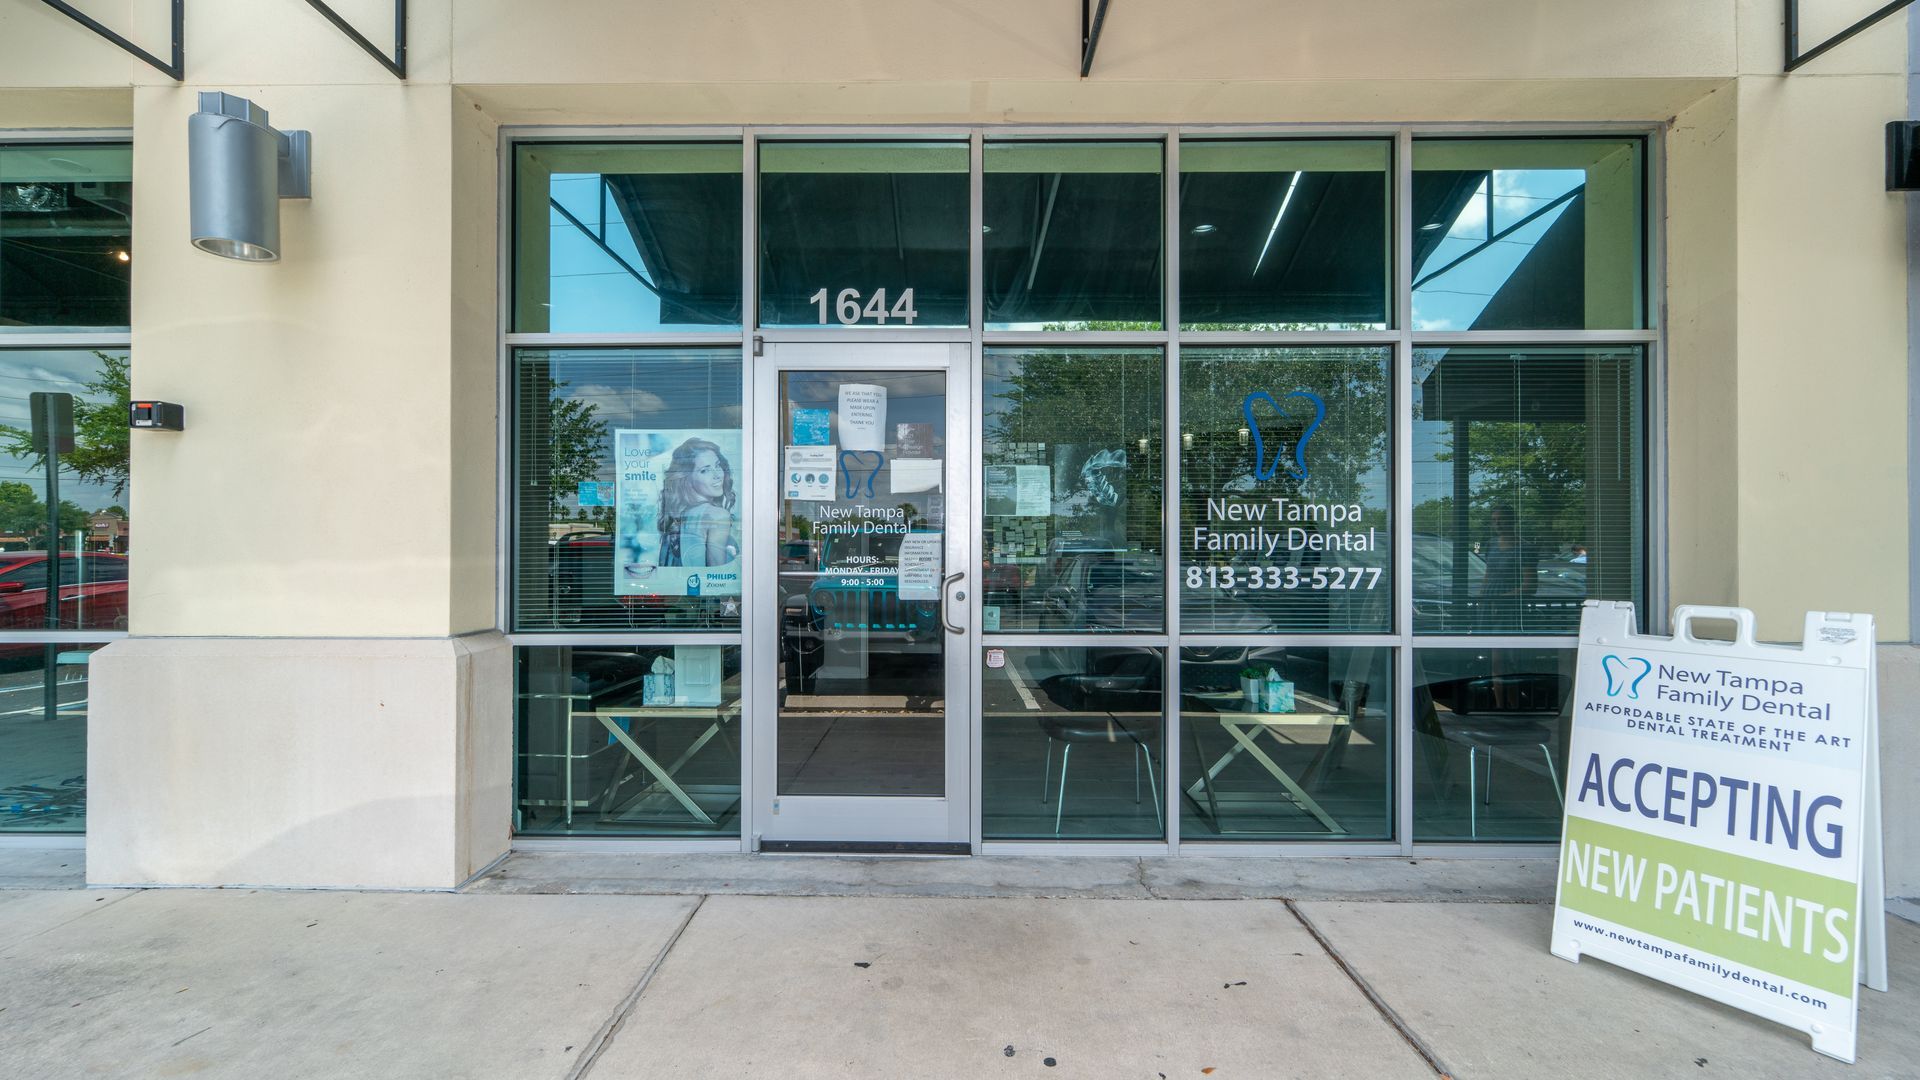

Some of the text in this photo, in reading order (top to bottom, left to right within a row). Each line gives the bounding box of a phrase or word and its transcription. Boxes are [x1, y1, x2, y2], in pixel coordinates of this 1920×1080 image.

[810, 287, 918, 325] 1644
[624, 447, 651, 457] Love
[624, 459, 650, 470] your
[624, 471, 657, 481] smile
[819, 504, 904, 523] New Tampa
[1207, 497, 1362, 527] New Tampa
[813, 520, 912, 537] Family Dental
[1194, 527, 1375, 558] Family Dental
[825, 567, 864, 575] MONDAY
[870, 567, 899, 575] FRIDAY
[846, 555, 879, 564] HOURS:
[841, 578, 860, 586] 9:00
[866, 578, 885, 586] 5:00
[1186, 566, 1382, 590] 813-333-5277
[1658, 664, 1804, 696] New Tampa
[1657, 684, 1831, 721] Family Dental
[1585, 702, 1851, 748] AFFORDABLE STATE OF THE ART
[1627, 718, 1791, 752] DENTAL TREATMENT
[1578, 752, 1844, 859] ACCEPTING
[1565, 839, 1849, 964] NEW PATIENTS
[1573, 918, 1828, 1010] www.newtampafamilydental.com
